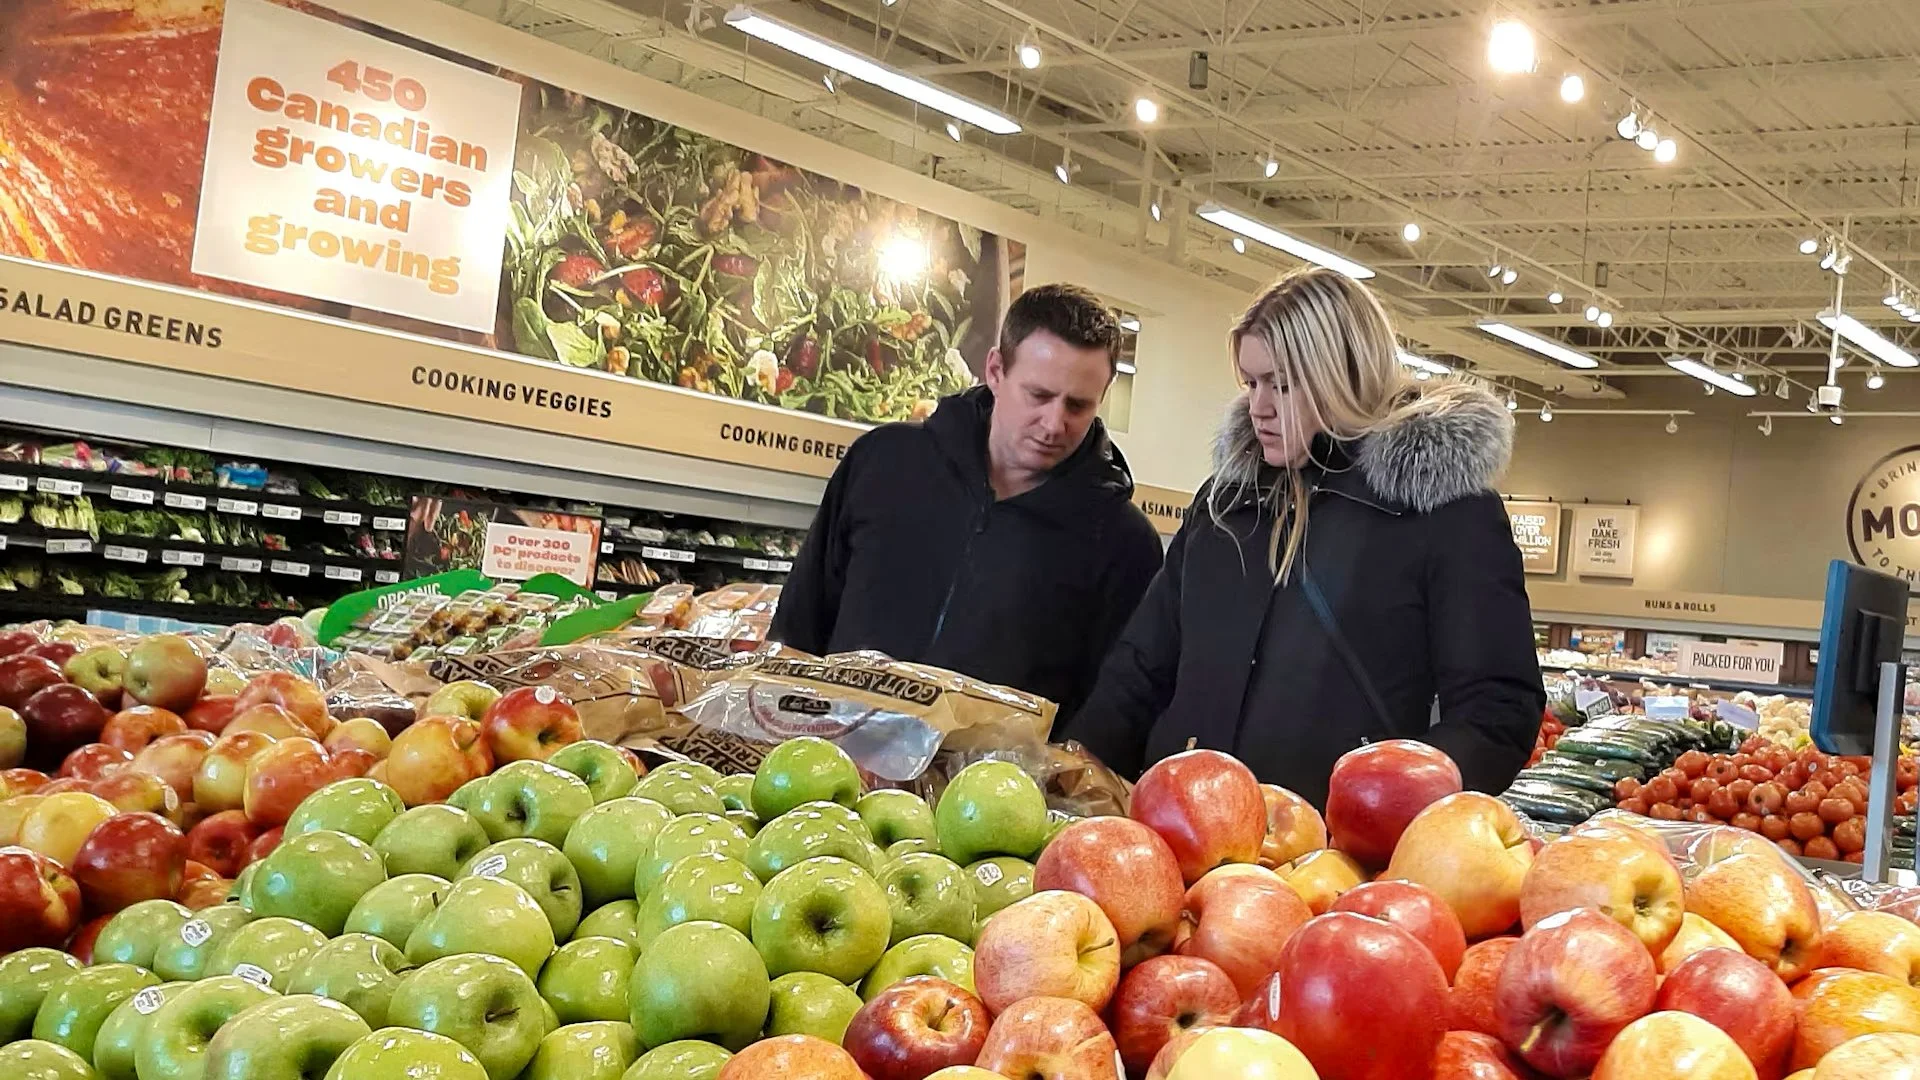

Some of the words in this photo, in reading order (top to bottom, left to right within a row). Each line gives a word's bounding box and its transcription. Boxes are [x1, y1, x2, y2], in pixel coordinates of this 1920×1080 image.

[326, 59, 427, 111] 450
[246, 77, 488, 173] Canadian
[251, 126, 472, 208] growers
[314, 185, 411, 233] and
[245, 214, 461, 294] growing
[104, 306, 223, 349] GREENS
[412, 366, 517, 402] COOKING
[522, 386, 612, 419] VEGGIES
[720, 423, 798, 452] COOKING
[802, 438, 851, 460] GREE
[1141, 500, 1173, 518] ASIAN
[1597, 518, 1614, 528] WE
[508, 536, 541, 548] Over
[542, 539, 571, 551] 300
[1588, 539, 1620, 549] FRESH
[496, 559, 512, 569] to
[514, 561, 575, 575] discover
[518, 550, 581, 563] products
[1872, 547, 1890, 567] TO
[1674, 602, 1681, 610] &
[1683, 602, 1716, 613] ROLLS
[1692, 652, 1731, 669] PACKED
[1732, 655, 1753, 671] FOR
[1754, 657, 1775, 673] YOU
